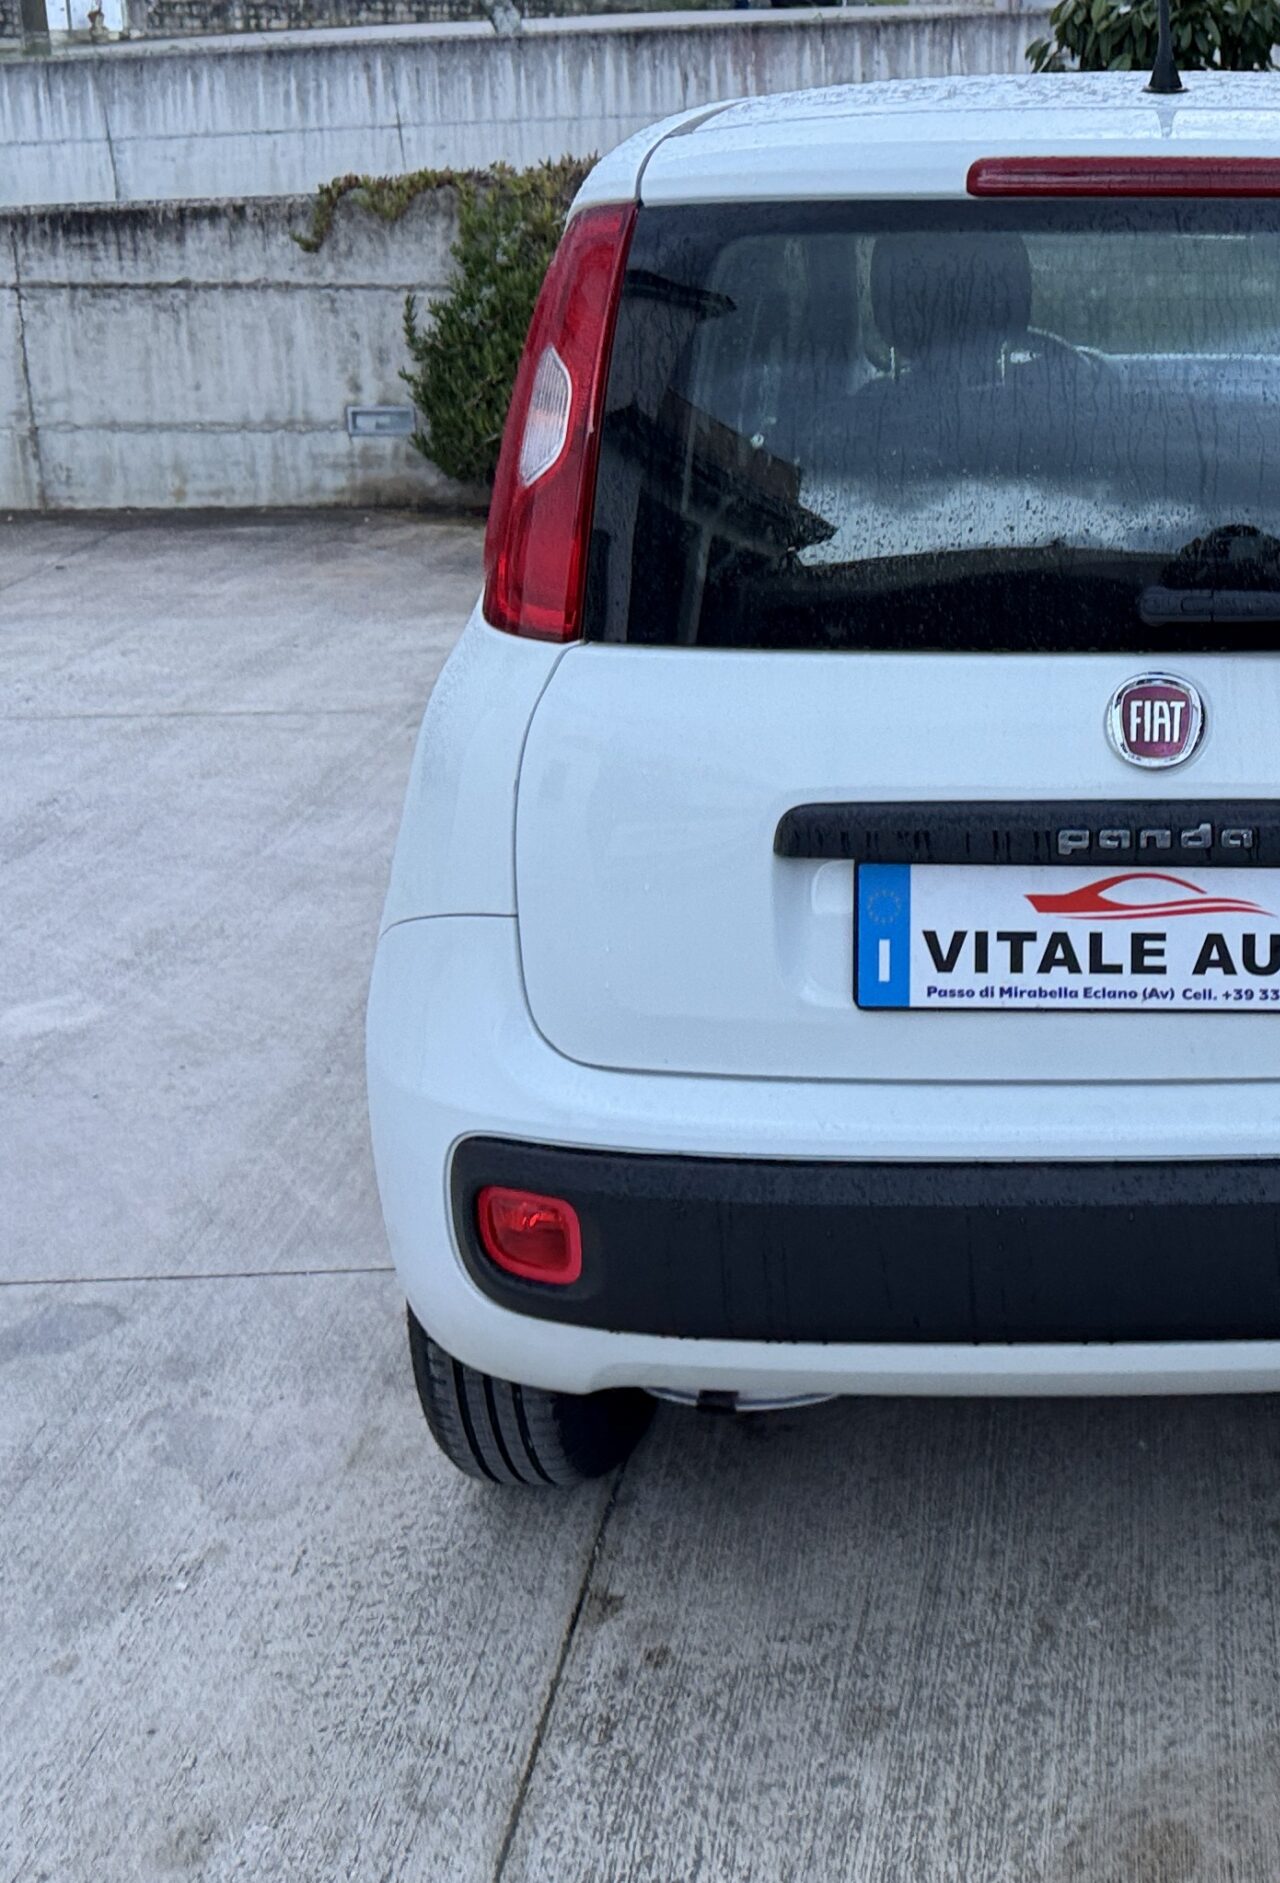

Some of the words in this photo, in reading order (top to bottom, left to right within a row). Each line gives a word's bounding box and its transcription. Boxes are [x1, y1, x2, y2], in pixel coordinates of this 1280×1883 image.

[1129, 700, 1186, 743] FIAT
[1057, 823, 1253, 855] panda
[879, 939, 890, 982] I
[922, 930, 1167, 975] VITALE
[926, 985, 975, 999] Passo
[979, 985, 995, 999] di
[1000, 986, 1079, 1000] Mirabella
[1083, 986, 1138, 1000] Eclano
[1142, 987, 1175, 1001] (Av)
[1181, 987, 1218, 1001] Cell.
[1222, 987, 1255, 1001] +39
